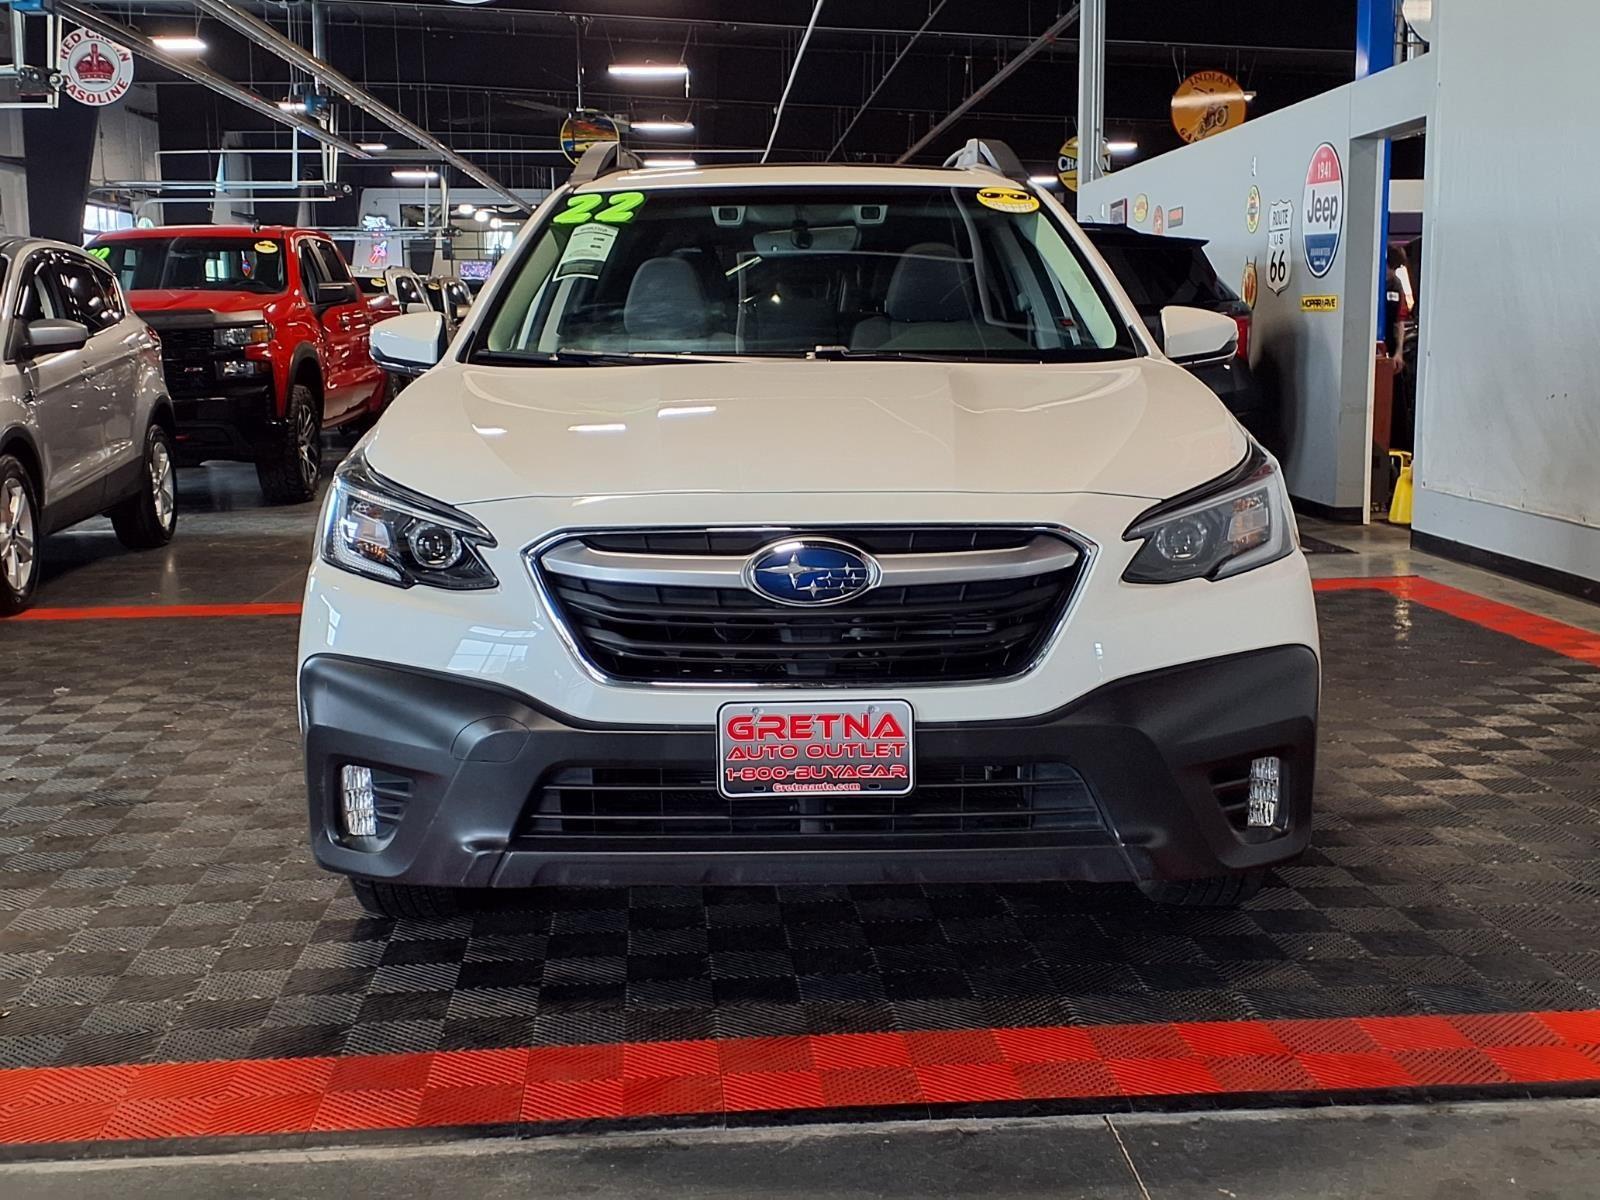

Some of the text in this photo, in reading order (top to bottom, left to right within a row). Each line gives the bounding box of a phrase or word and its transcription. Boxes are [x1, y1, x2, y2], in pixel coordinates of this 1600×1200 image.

[60, 33, 81, 60] RED
[1189, 72, 1234, 88] INDIAN
[1317, 160, 1332, 180] 1941
[553, 192, 645, 224] 22
[1272, 208, 1289, 226] ROUTE
[1307, 189, 1338, 230] Jeep
[1269, 249, 1287, 283] 66
[726, 712, 905, 741] GRETNA
[726, 742, 908, 761] AUTO OUTLET
[725, 764, 908, 782] 1-800-BUYACAR
